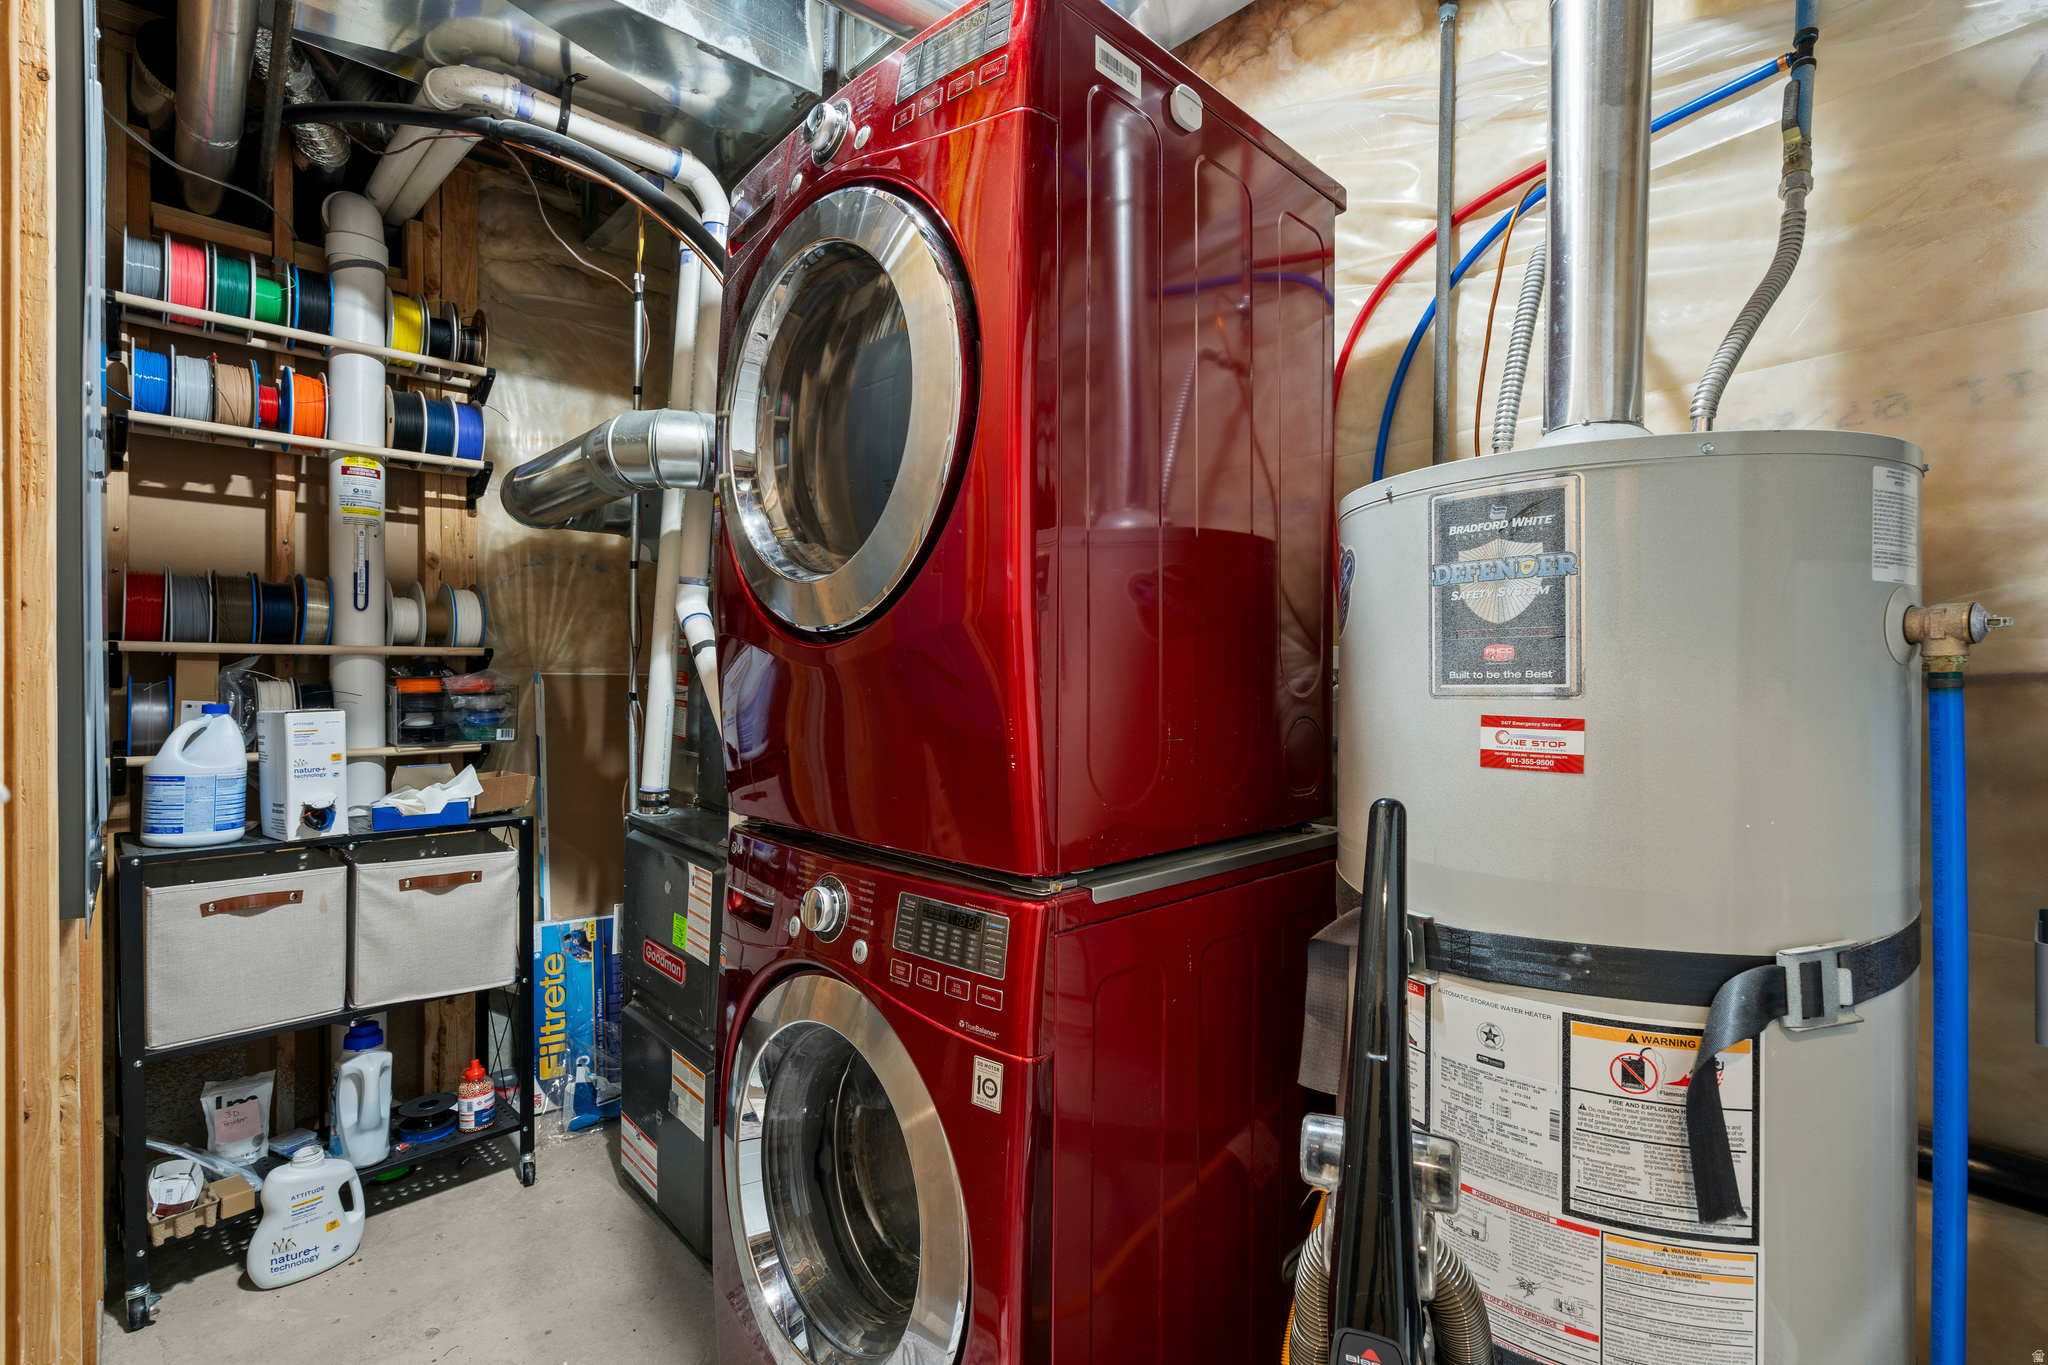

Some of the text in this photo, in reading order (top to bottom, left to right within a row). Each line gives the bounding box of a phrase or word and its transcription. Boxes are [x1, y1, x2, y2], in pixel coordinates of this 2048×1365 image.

[1449, 515, 1553, 535] BRADFORD WHITE
[1433, 552, 1578, 586] DEFENDER
[1451, 585, 1550, 600] SAFETY SYSTEM
[1449, 670, 1553, 679] Built to be the Best
[1532, 740, 1567, 748] STOP
[1506, 757, 1554, 766] 801-355-9500
[293, 766, 326, 774] nature+
[646, 945, 681, 977] Goodman
[981, 993, 996, 1002] SIGNAL
[1438, 988, 1552, 1020] AUTOMATIC STORAGE WATER HEATER
[539, 952, 566, 1080] Filtrete
[1641, 1035, 1696, 1049] WARNING
[984, 1063, 1000, 1072] MOTOR
[977, 1075, 998, 1099] 10
[1641, 1104, 1680, 1114] EXPLOSION
[1577, 1110, 1594, 1118] liquids
[1611, 1116, 1629, 1125] vicinity
[1639, 1114, 1662, 1123] gasoline
[1595, 1119, 1616, 1128] gasoline
[1640, 1126, 1667, 1135] flammable
[1668, 1130, 1687, 1138] vapors
[1627, 1130, 1652, 1139] appliance
[1572, 1130, 1590, 1138] Vapors
[1603, 1137, 1630, 1146] flammable
[1596, 1145, 1616, 1153] causing
[290, 1185, 326, 1201] ATTITUDE
[1475, 1191, 1550, 1222] OPERATING INSTRUCTIONS
[270, 1245, 320, 1266] nature+
[1667, 1252, 1685, 1260] YOUR
[1685, 1255, 1709, 1263] SAFETY
[1671, 1248, 1703, 1257] WARNING
[270, 1253, 320, 1274] technology
[1642, 1270, 1664, 1279] PRODUCE
[1671, 1270, 1703, 1279] WARNING
[1491, 1295, 1558, 1328] OFF GAS TO APPLIANCE
